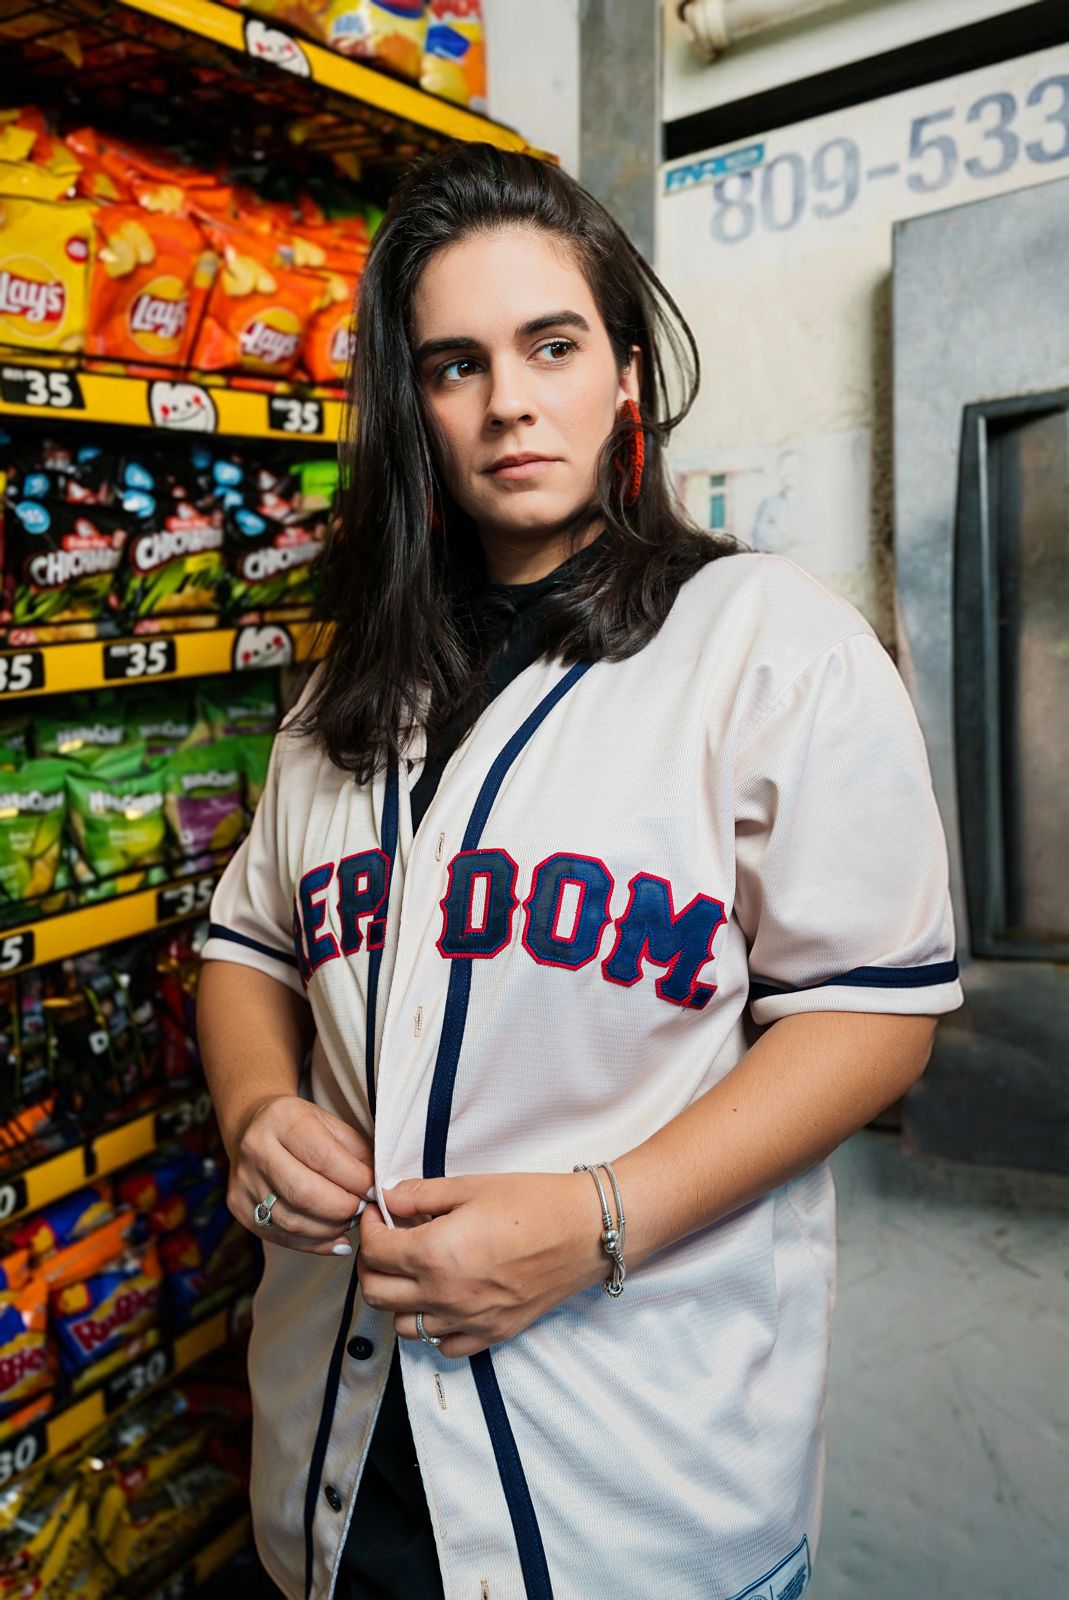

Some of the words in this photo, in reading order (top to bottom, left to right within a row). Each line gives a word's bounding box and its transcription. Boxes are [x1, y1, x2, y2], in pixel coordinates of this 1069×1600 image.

[25, 369, 73, 407] 35
[284, 399, 320, 433] 35
[125, 641, 168, 677] 35
[177, 878, 213, 915] 35
